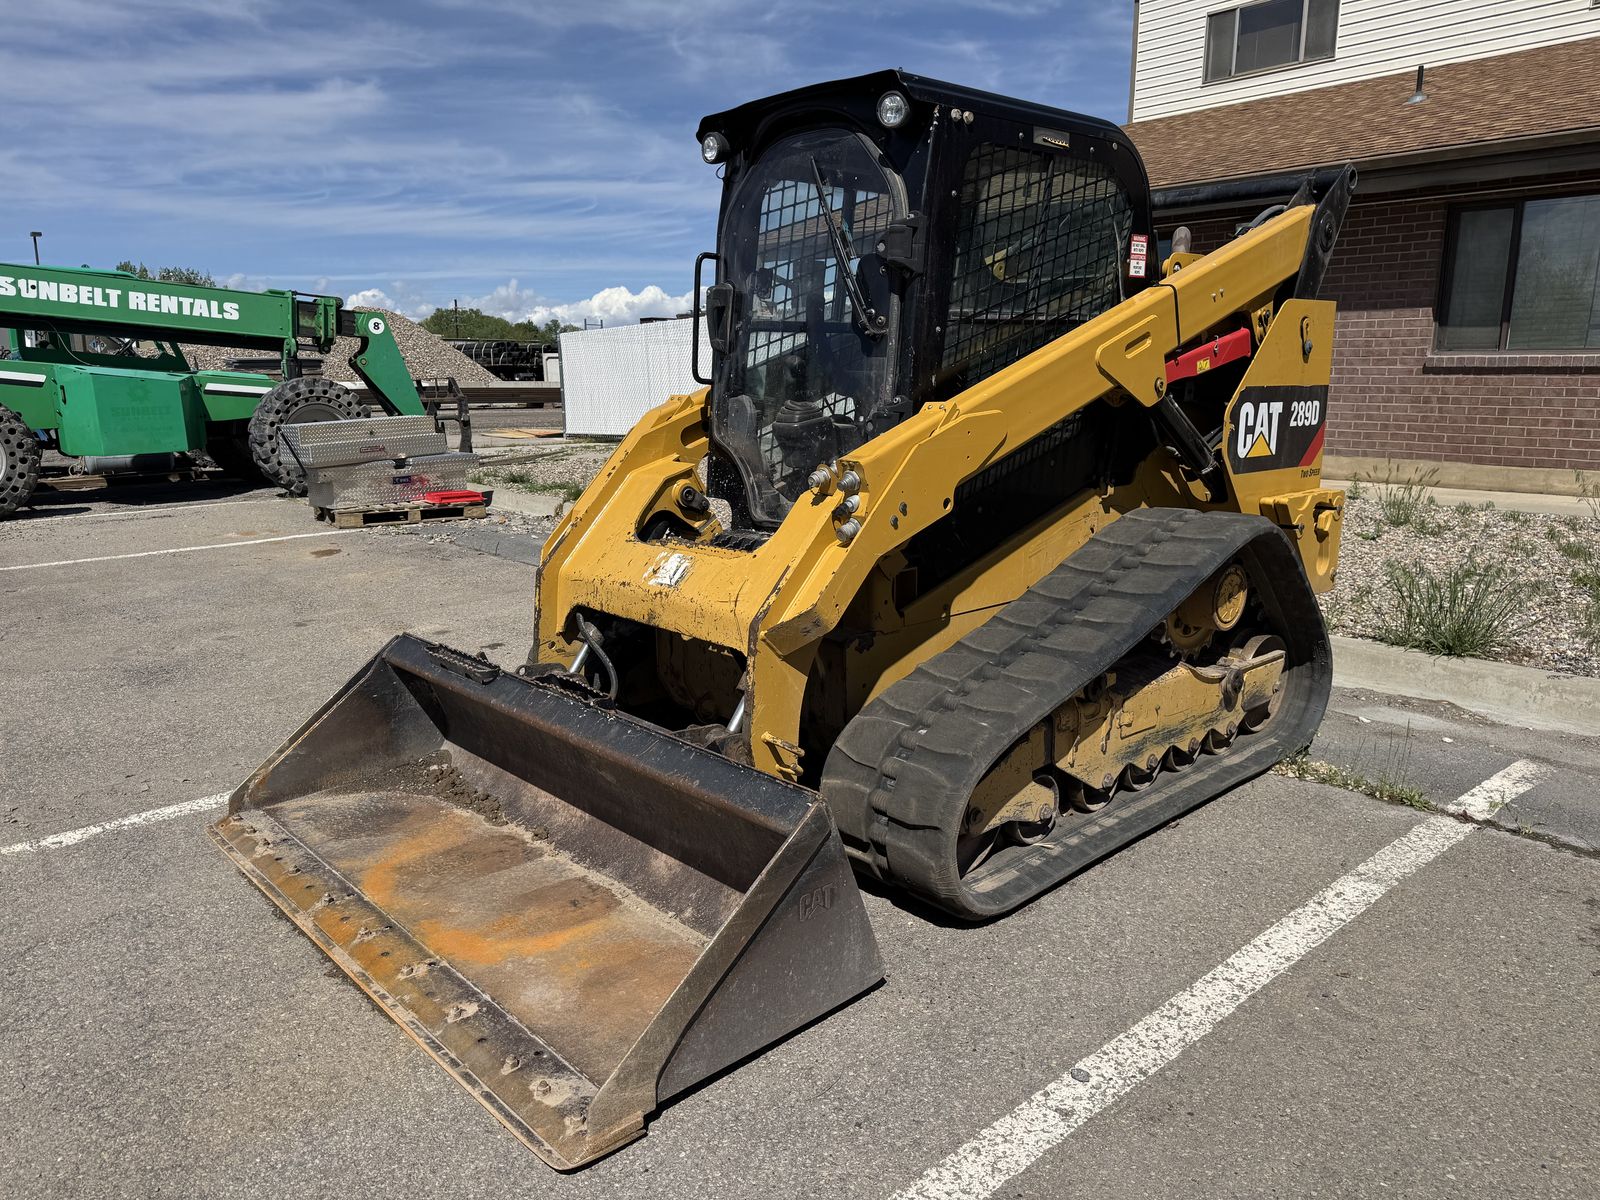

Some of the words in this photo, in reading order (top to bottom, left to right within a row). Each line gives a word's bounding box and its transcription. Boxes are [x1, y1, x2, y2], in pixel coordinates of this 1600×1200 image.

[0, 276, 122, 308] SUNBELT
[128, 291, 240, 320] RENTALS
[1237, 401, 1283, 459] CAT
[1289, 400, 1320, 427] 289D
[799, 882, 833, 922] CAT
